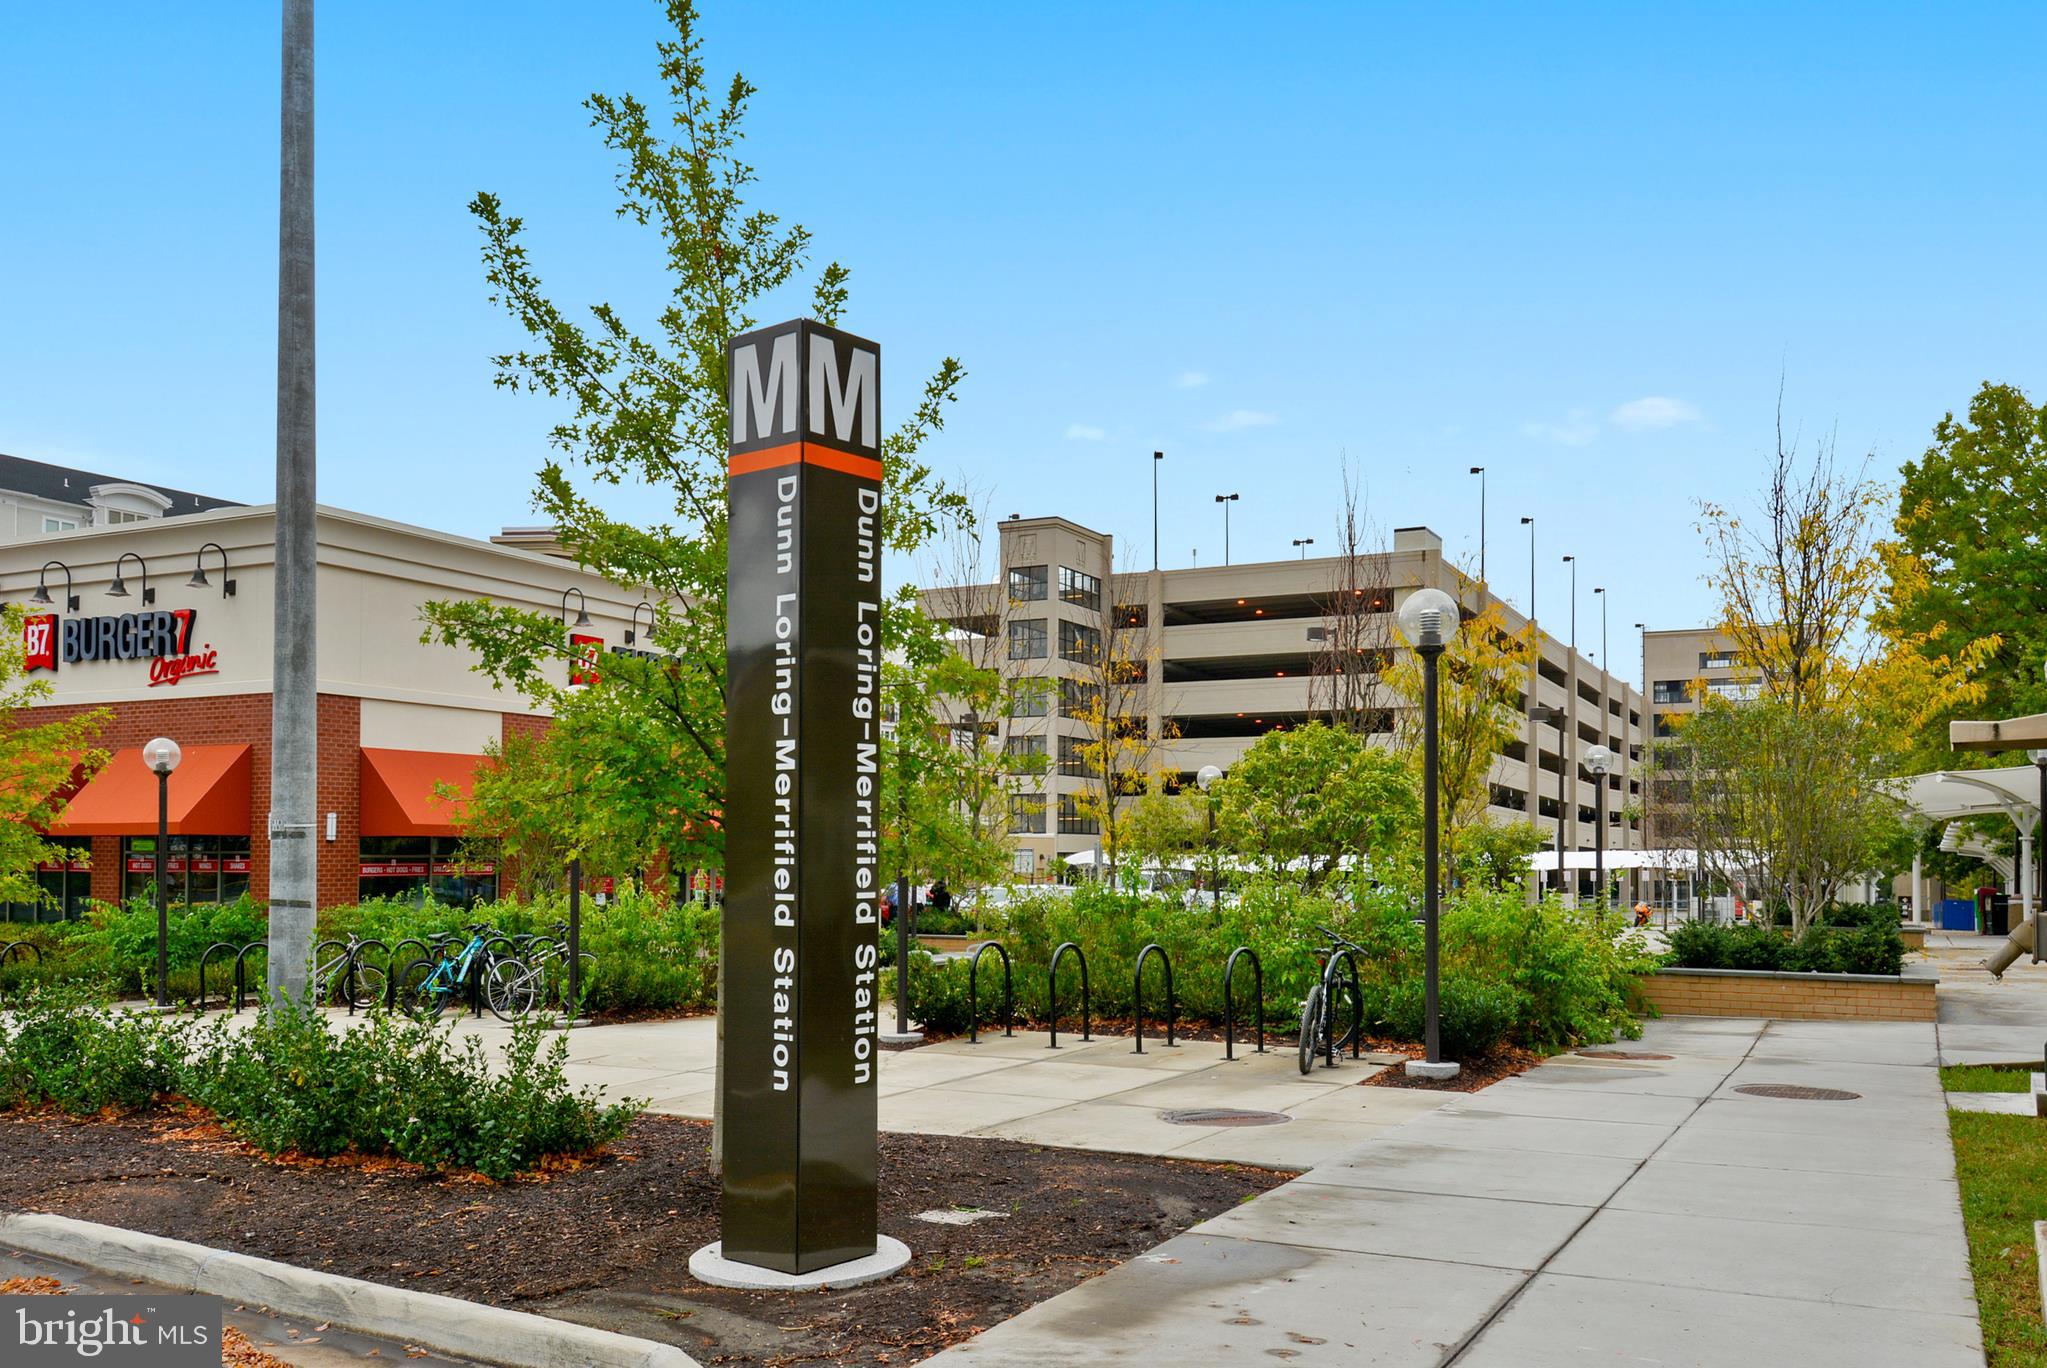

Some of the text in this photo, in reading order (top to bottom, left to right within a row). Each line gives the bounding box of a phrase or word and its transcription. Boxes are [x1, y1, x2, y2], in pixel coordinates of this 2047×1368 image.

[733, 331, 797, 444] M
[809, 332, 876, 449] M
[776, 475, 797, 574] Dunn
[858, 488, 878, 582] Dunn
[150, 643, 218, 686] Organic
[773, 947, 795, 1091] Station
[854, 944, 876, 1084] Station
